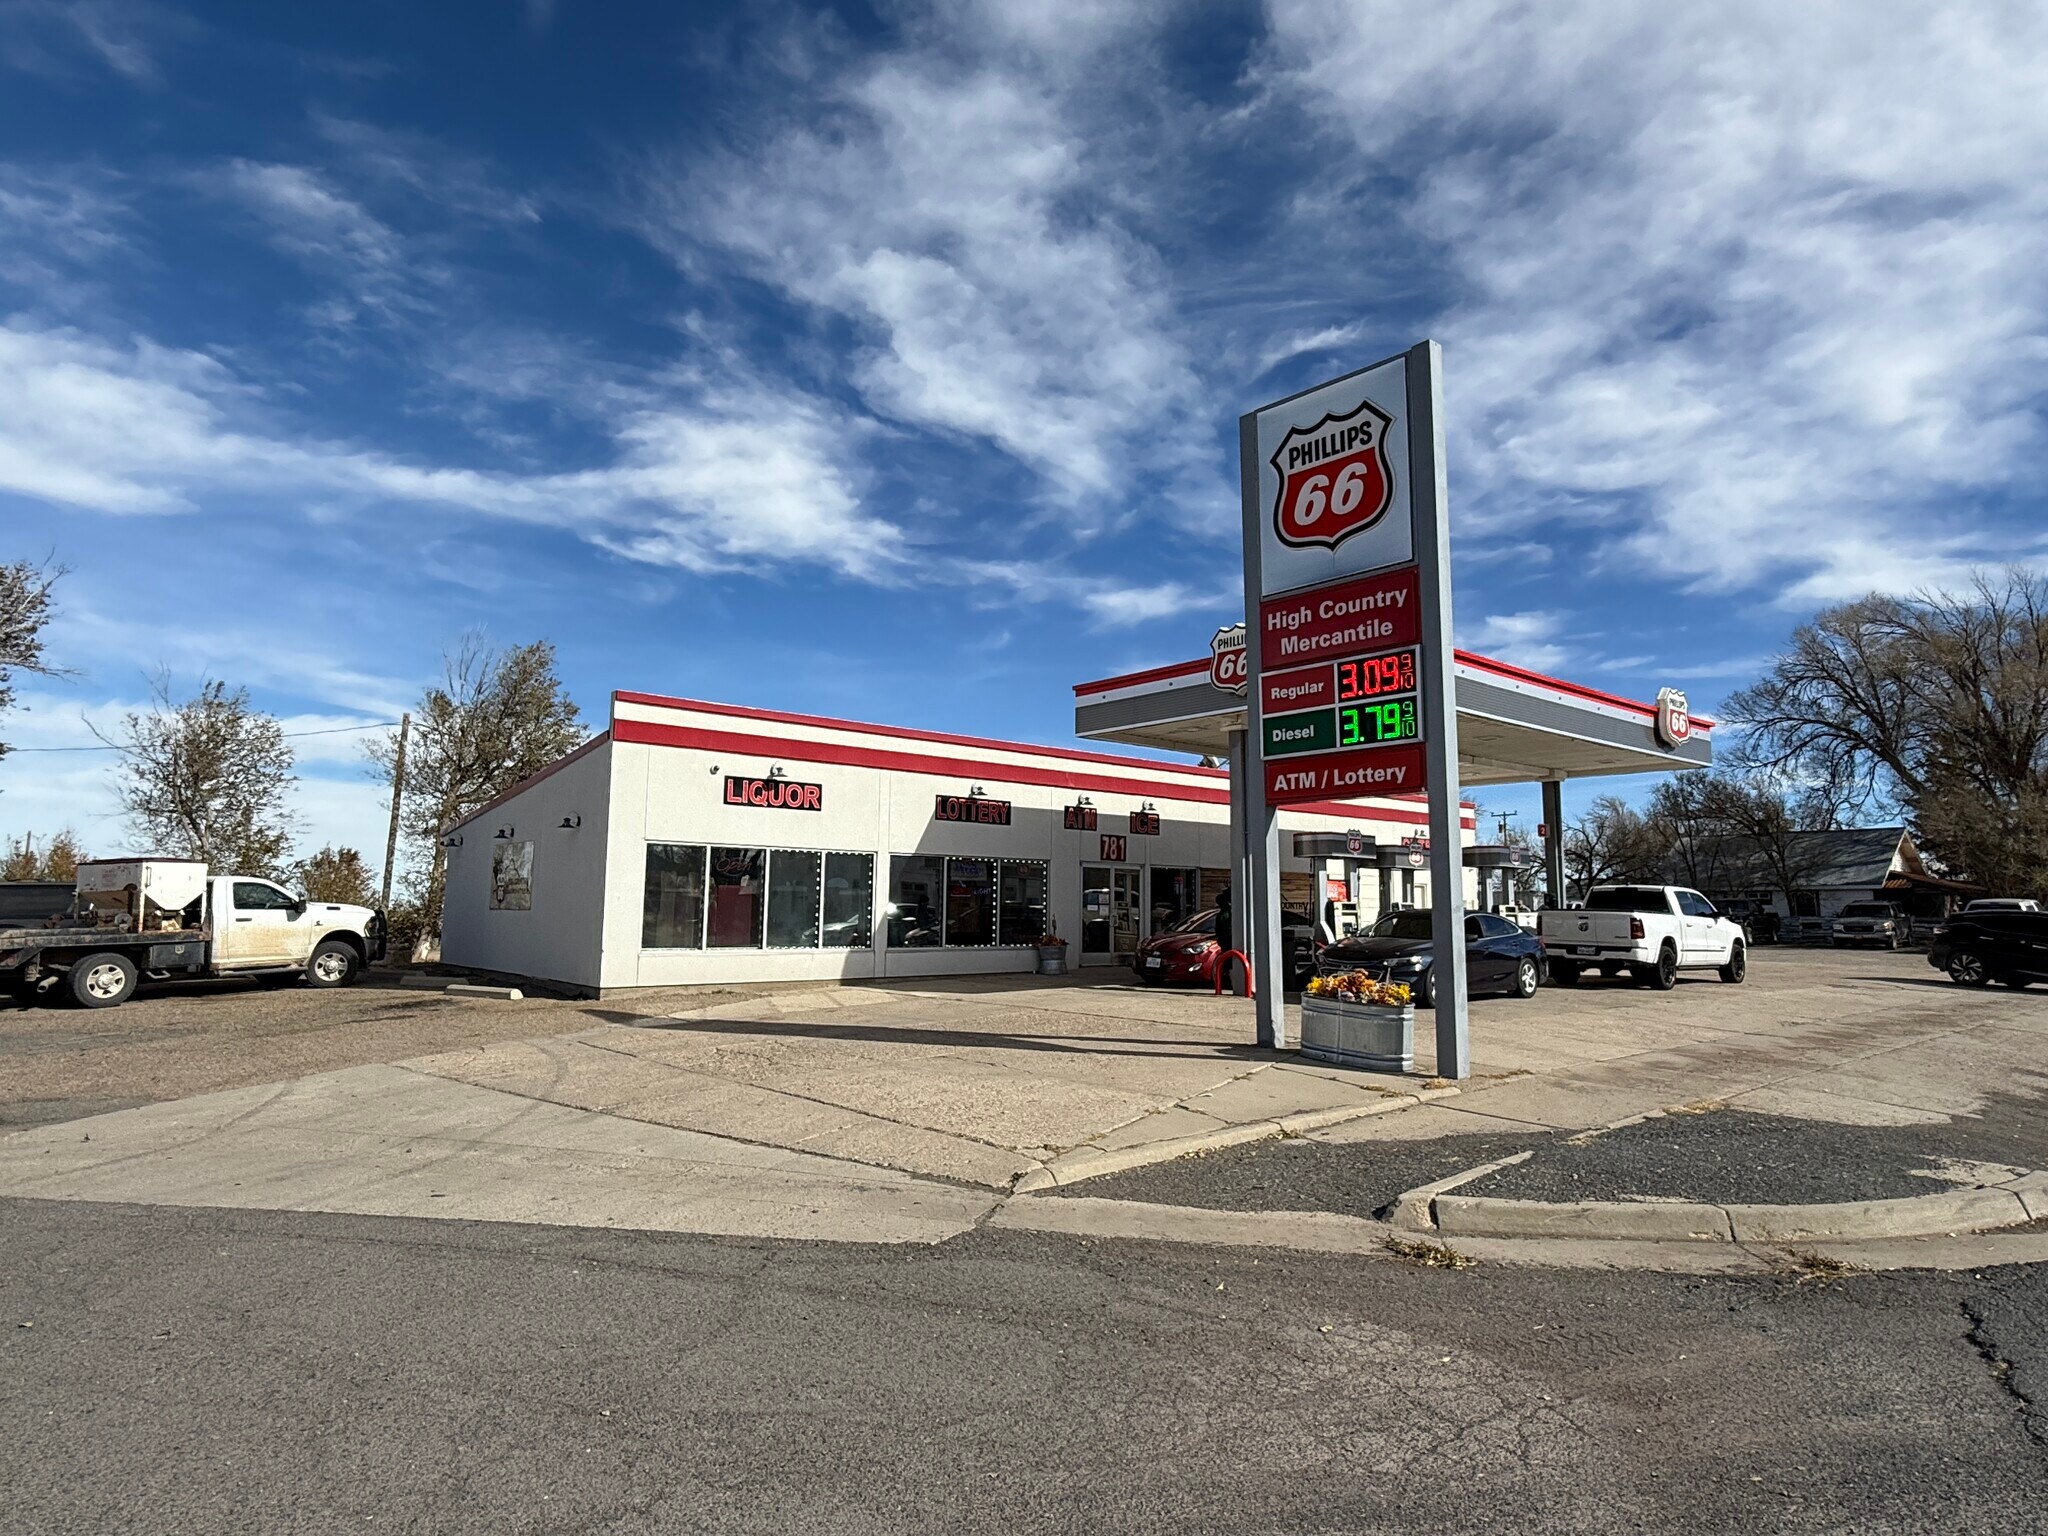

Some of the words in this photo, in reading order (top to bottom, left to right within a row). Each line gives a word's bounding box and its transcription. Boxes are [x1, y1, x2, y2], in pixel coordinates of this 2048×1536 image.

[1288, 420, 1373, 471] PHILLIPS
[1293, 461, 1368, 527] 66
[1267, 606, 1312, 631] High
[1319, 588, 1408, 619] Country
[1217, 634, 1246, 650] PHILLI
[1280, 618, 1393, 656] Mercantile
[1218, 651, 1247, 679] 66
[1270, 682, 1325, 700] Regular
[1340, 656, 1399, 699] 3.09
[1272, 724, 1315, 742] Diesel
[1341, 702, 1400, 744] 3.79
[1671, 711, 1686, 734] 66
[1273, 772, 1316, 791] ATM
[1333, 766, 1407, 787] Lottery
[726, 778, 820, 809] LIQUOR
[935, 796, 1010, 824] LOTTERY
[1065, 806, 1097, 830] ATM
[1130, 813, 1159, 835] ICE
[1101, 836, 1126, 860] 781
[1349, 839, 1360, 849] 66
[1281, 901, 1309, 917] OUNTRY
